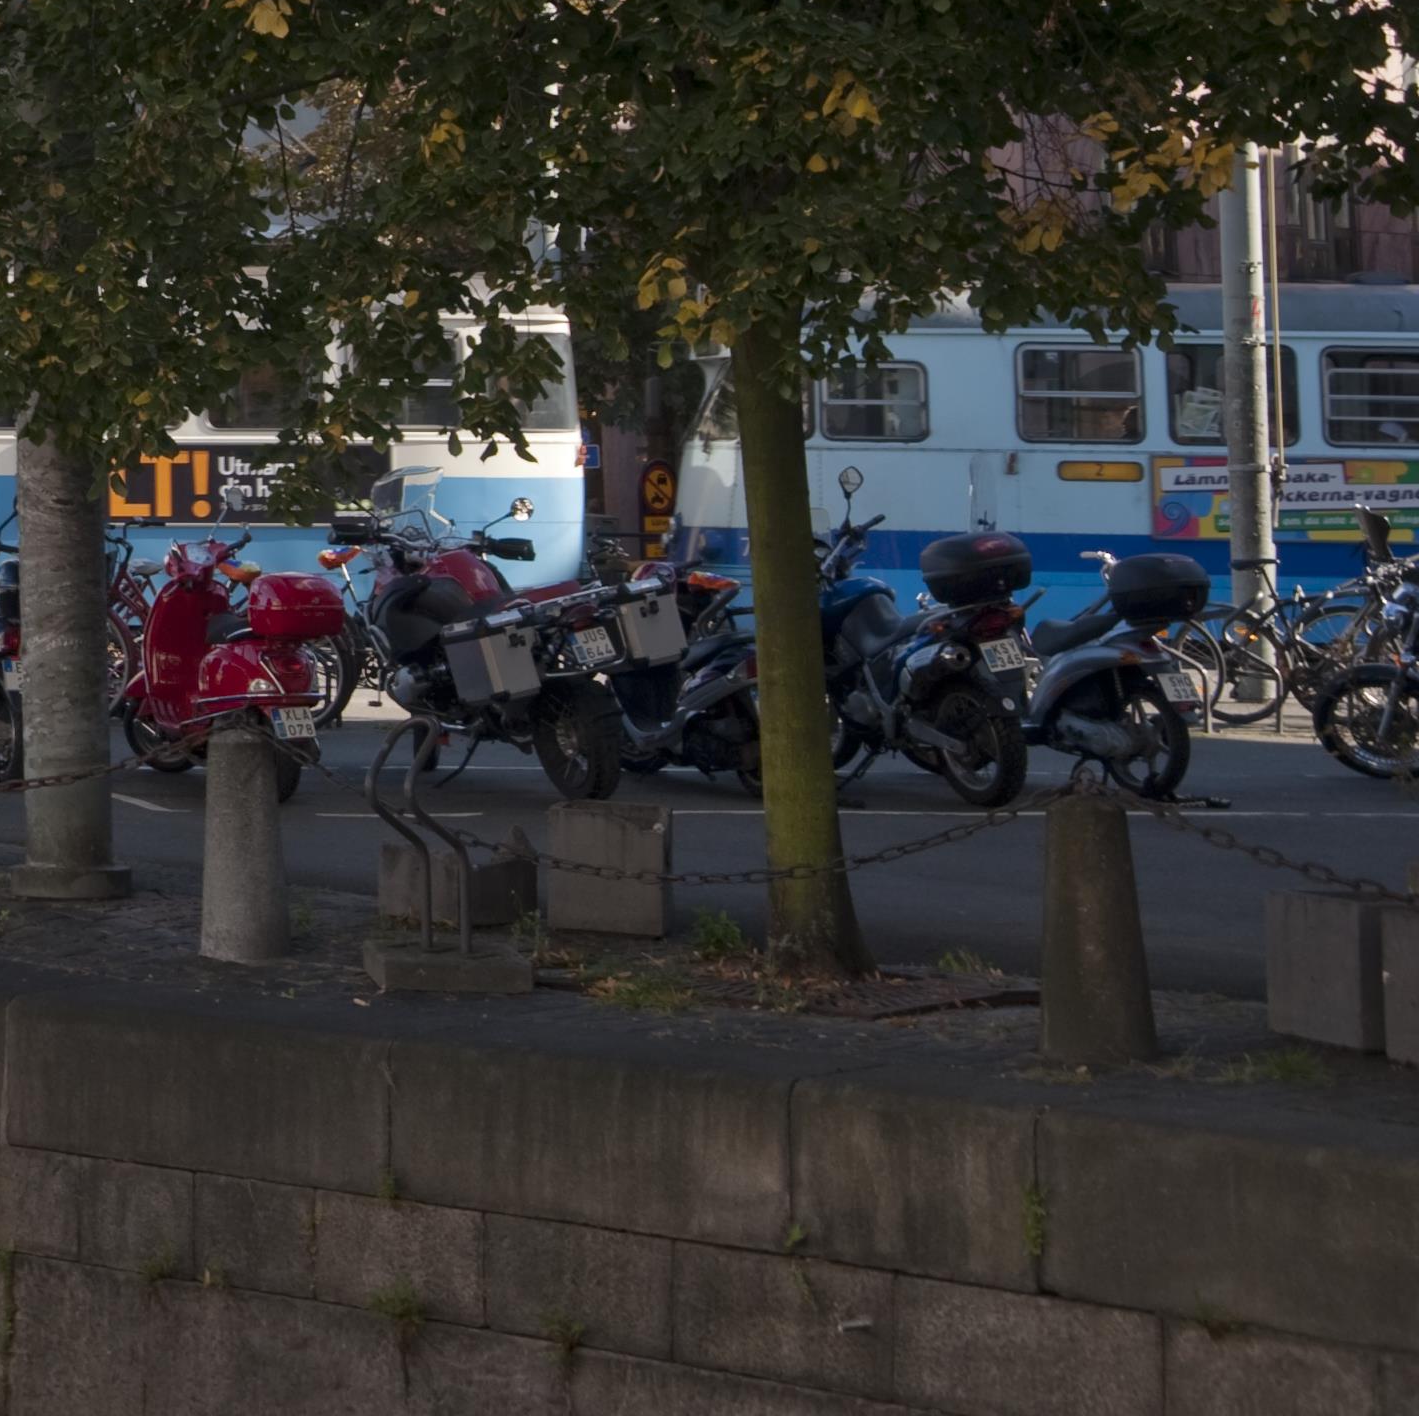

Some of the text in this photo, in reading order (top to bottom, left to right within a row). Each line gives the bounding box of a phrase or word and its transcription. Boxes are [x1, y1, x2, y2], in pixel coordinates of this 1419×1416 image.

[1174, 473, 1228, 486] Lämn
[583, 628, 606, 644] JUS
[284, 709, 310, 721] XLA
[288, 723, 313, 736] 078
